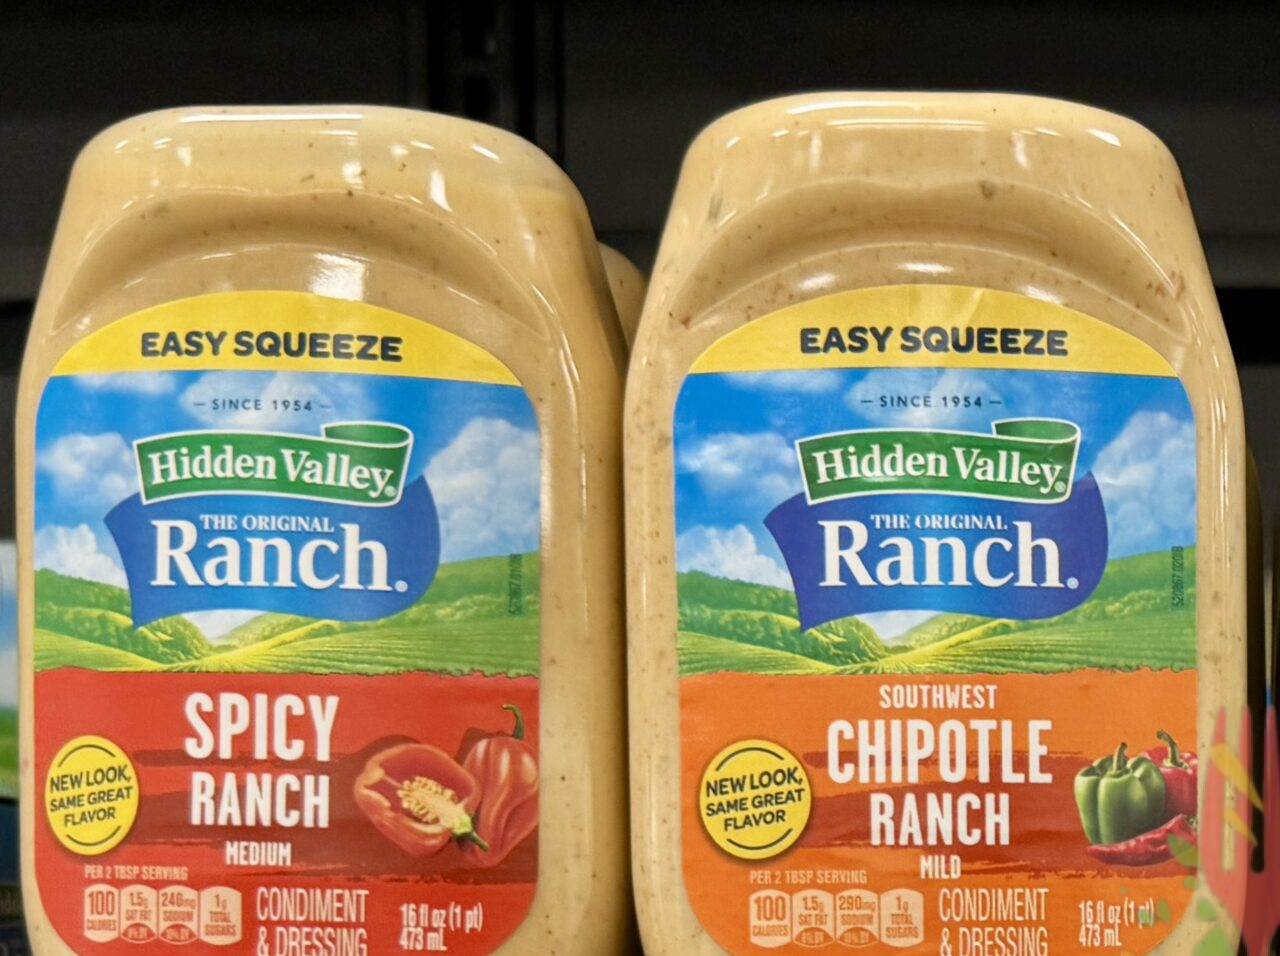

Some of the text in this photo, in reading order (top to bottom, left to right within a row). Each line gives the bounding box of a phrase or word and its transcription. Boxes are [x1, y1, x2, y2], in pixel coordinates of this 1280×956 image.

[141, 330, 403, 362] EASY SQUEEZE
[800, 327, 1069, 356] EASY SQUEEZE
[211, 398, 313, 412] SINCE 1954
[880, 395, 982, 408] SINCE 1954
[147, 447, 278, 488] Hidden
[812, 444, 949, 484] Hidden
[201, 514, 334, 533] THE ORIGINAL
[871, 514, 1008, 530] THE ORIGINAL
[879, 684, 998, 709] SOUTHWEST
[184, 692, 340, 763] SPICY
[827, 720, 1052, 784] CHIPOTLE
[49, 765, 132, 792] NEW LOOK,
[705, 766, 804, 798] NEW LOOK,
[49, 786, 134, 813] SAME GREAT
[189, 772, 330, 828] RANCH
[706, 788, 805, 817] SAME GREAT
[63, 806, 116, 827] FLAVOR
[723, 809, 786, 831] FLAVOR
[870, 793, 1010, 847] RANCH
[225, 841, 291, 866] MEDIUM
[920, 855, 961, 880] MILD
[256, 887, 369, 922] CONDIMENT
[938, 888, 1049, 922] CONDIMENT
